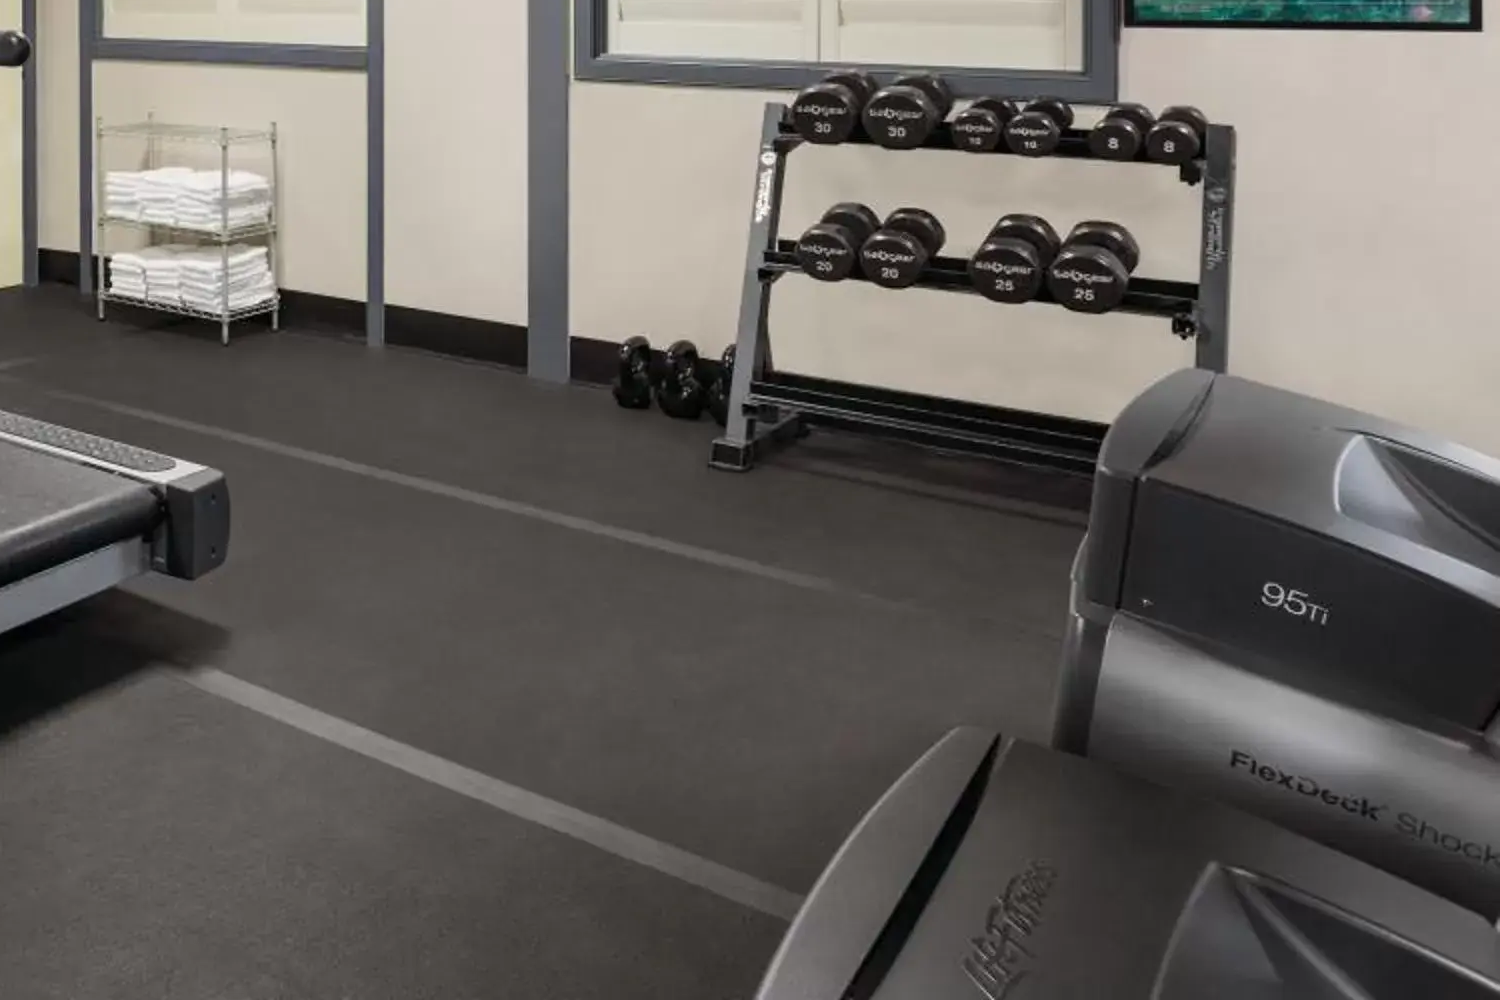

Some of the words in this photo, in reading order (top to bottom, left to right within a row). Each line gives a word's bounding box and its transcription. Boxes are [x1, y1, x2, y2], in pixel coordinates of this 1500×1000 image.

[814, 122, 832, 133] 30
[887, 126, 907, 137] 30
[1108, 137, 1119, 150] 8
[1163, 140, 1175, 153] 8
[816, 261, 833, 272] 20
[881, 267, 899, 279] 20
[995, 279, 1015, 291] 25
[1074, 287, 1095, 301] 25
[1261, 582, 1329, 625] 95Ti
[1230, 750, 1380, 821] FlexDeck
[1396, 811, 1500, 866] Shock
